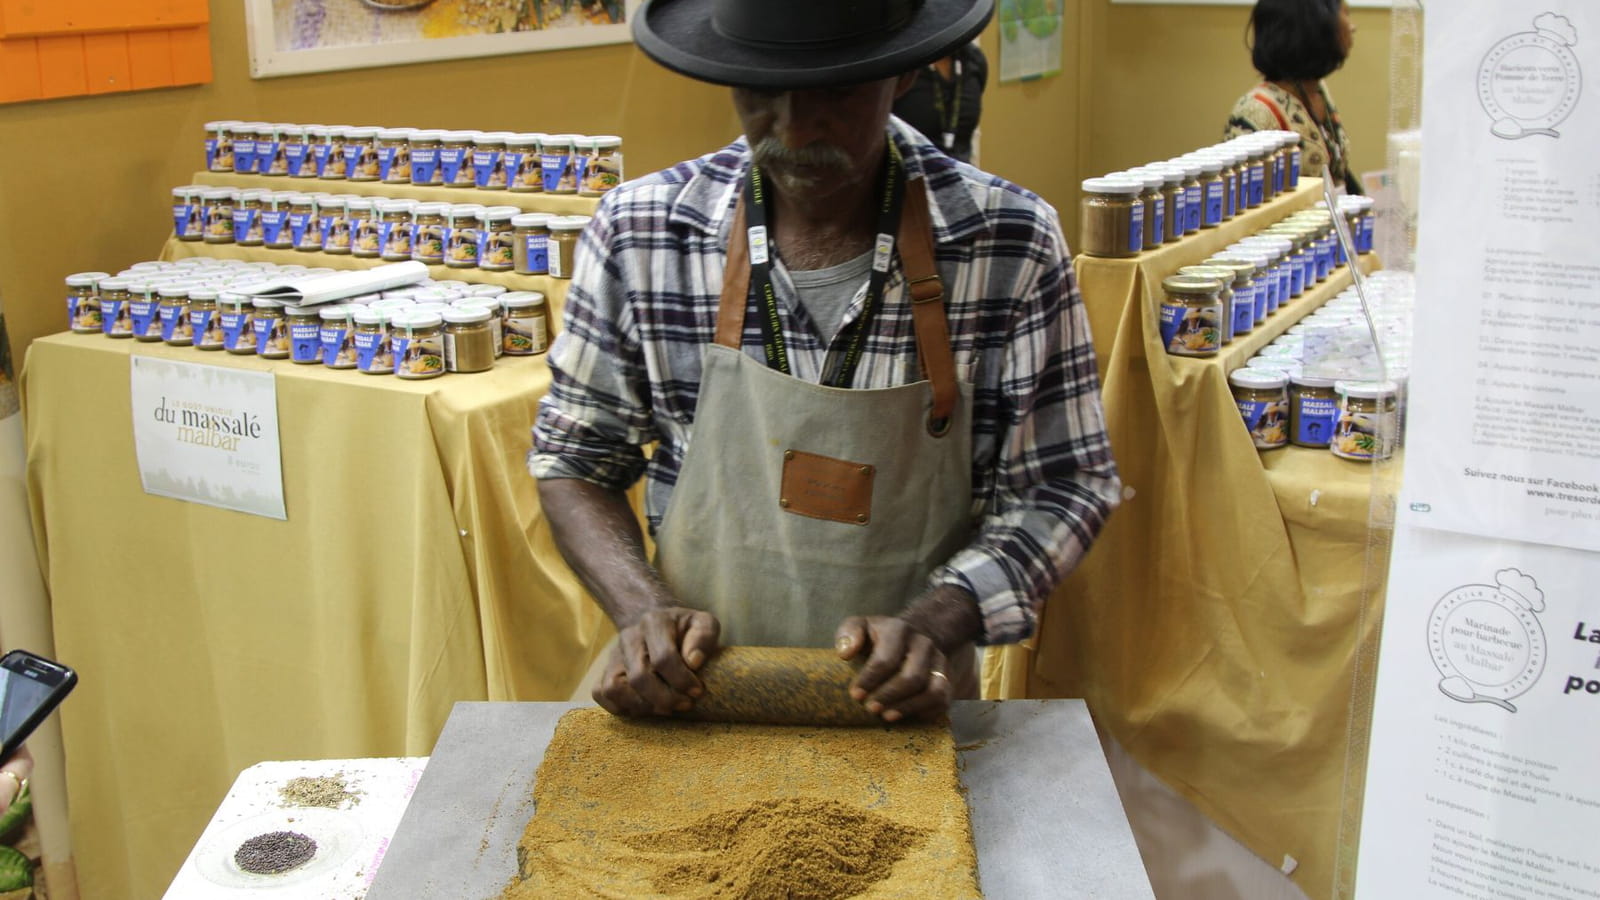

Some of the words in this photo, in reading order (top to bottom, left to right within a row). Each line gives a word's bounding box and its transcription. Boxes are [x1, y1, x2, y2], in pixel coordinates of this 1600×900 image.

[154, 396, 176, 424] du
[182, 411, 261, 439] massalé
[176, 421, 241, 452] malbar
[1464, 467, 1498, 480] Suivez
[1500, 473, 1525, 484] nous
[1528, 477, 1544, 486] sur
[1547, 478, 1599, 493] Facebook
[1450, 625, 1475, 638] pour
[1476, 630, 1523, 650] barbecue
[1465, 617, 1512, 636] Marinade
